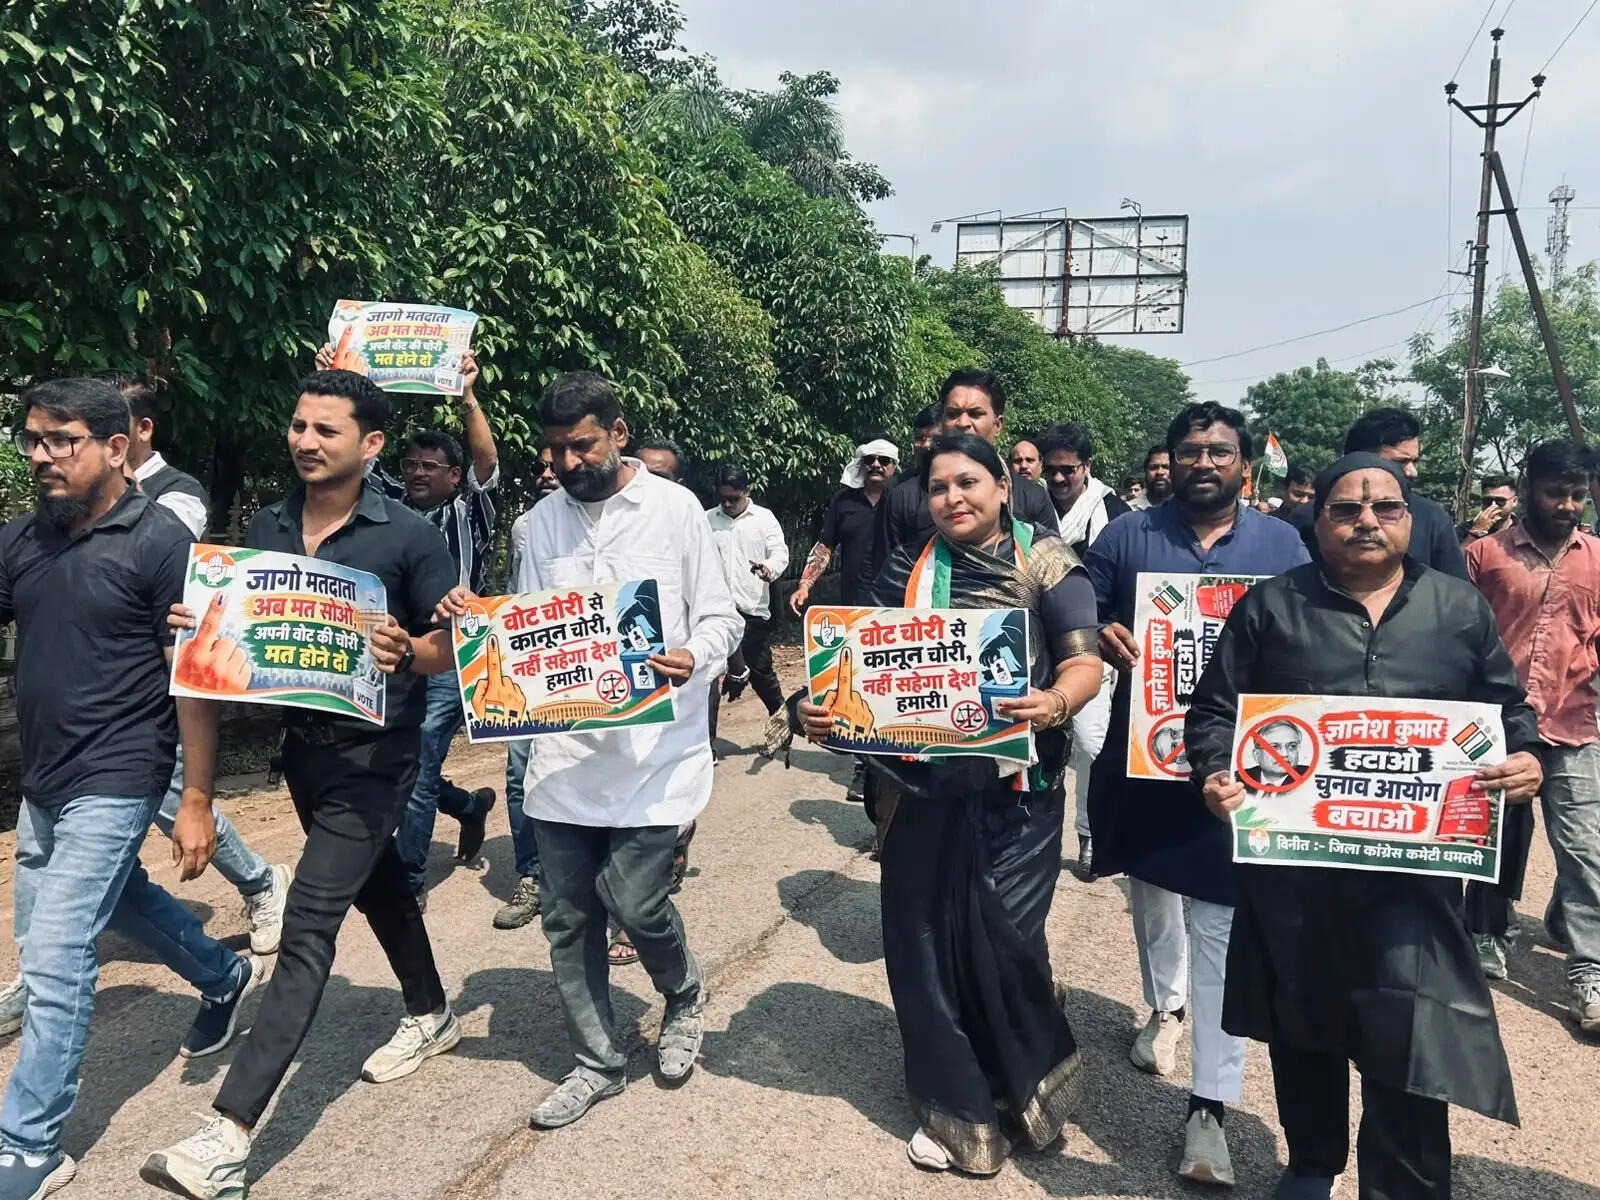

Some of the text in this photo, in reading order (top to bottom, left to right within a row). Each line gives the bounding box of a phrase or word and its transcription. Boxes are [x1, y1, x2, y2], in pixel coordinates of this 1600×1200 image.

[366, 308, 451, 323] जागो मतदाता
[368, 326, 389, 337] अब
[392, 325, 410, 337] मत
[368, 339, 443, 351] अपनी वोट की चोरी
[374, 352, 432, 367] मत होने दो
[437, 376, 453, 386] VOTE
[246, 563, 356, 601] जागो मतदाता
[252, 598, 358, 630] अब मत सोओ,
[502, 591, 604, 632] वोट चोरी से
[254, 622, 358, 651] अपनी वोट की चोरी
[510, 612, 611, 651] कानून चोरी,
[859, 614, 966, 646] वोट चोरी से
[264, 644, 349, 672] मत होने दो
[512, 639, 618, 677] नहीं सहेगा देश
[863, 641, 972, 670] कानून चोरी,
[1146, 622, 1174, 713] ज्ञानेश कुमार
[1174, 638, 1195, 696] हटाओ
[862, 669, 978, 696] नहीं सहेगा देश
[356, 692, 374, 710] VOTE
[1326, 714, 1444, 748] ज्ञानेश कुमार
[1344, 748, 1422, 772] हटाओ
[1315, 774, 1442, 802] चुनाव आयोग
[1328, 801, 1416, 830] बचाओ
[1276, 834, 1310, 852] विनीत
[1328, 838, 1361, 856] जिला
[1364, 843, 1404, 859] कांग्रेस
[1406, 846, 1441, 862] कमेटी
[1443, 850, 1484, 866] धमतरी
